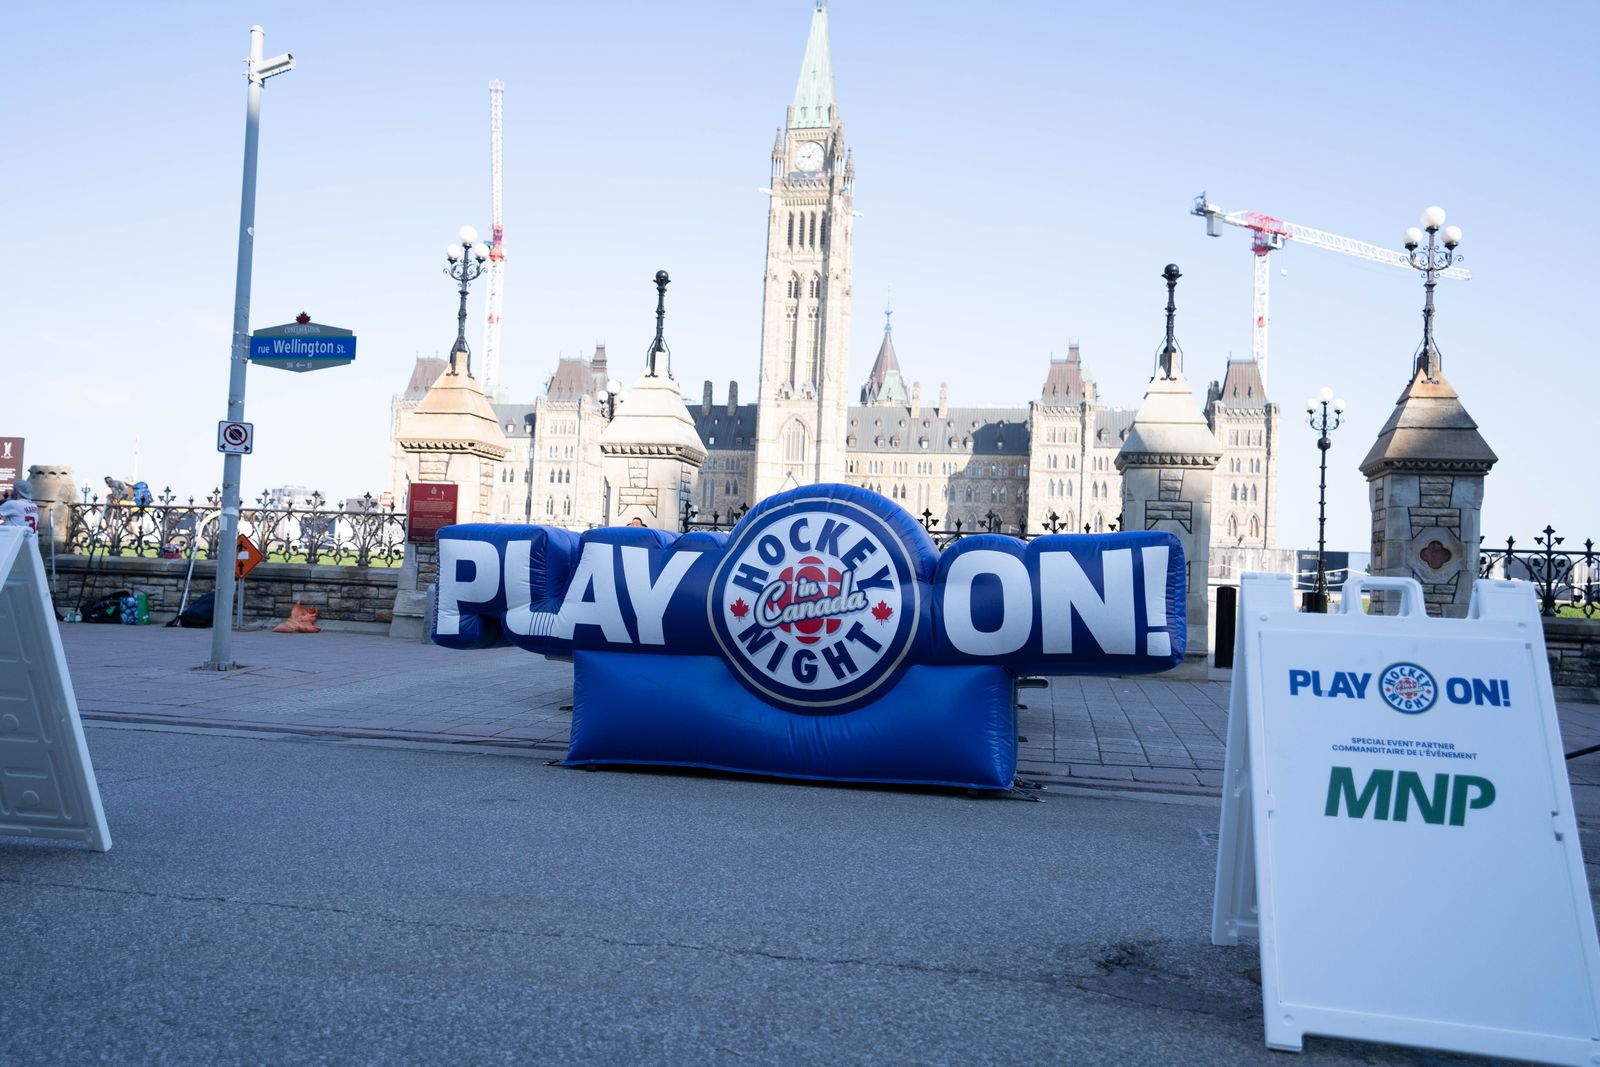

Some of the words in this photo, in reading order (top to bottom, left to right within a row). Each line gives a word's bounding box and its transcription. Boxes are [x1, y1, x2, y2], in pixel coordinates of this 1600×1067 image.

[258, 345, 270, 354] rue
[273, 339, 334, 358] Wellington
[336, 344, 347, 354] St.
[732, 517, 895, 594] HOCKEY
[437, 538, 704, 645] PLAY
[943, 545, 1172, 656] ON!
[754, 570, 868, 629] Canada
[798, 577, 819, 598] in
[737, 621, 883, 684] NIGHT
[1289, 669, 1372, 699] PLAY
[1446, 677, 1511, 707] ON!
[1384, 667, 1432, 687] HOCKEY
[1387, 693, 1430, 710] NIGHT
[1331, 744, 1405, 756] COMMANDITAIRE
[1351, 737, 1386, 746] SPECIAL
[1387, 739, 1414, 748] EVENT
[1416, 741, 1455, 750] PARTNER
[1324, 766, 1496, 827] MNP
